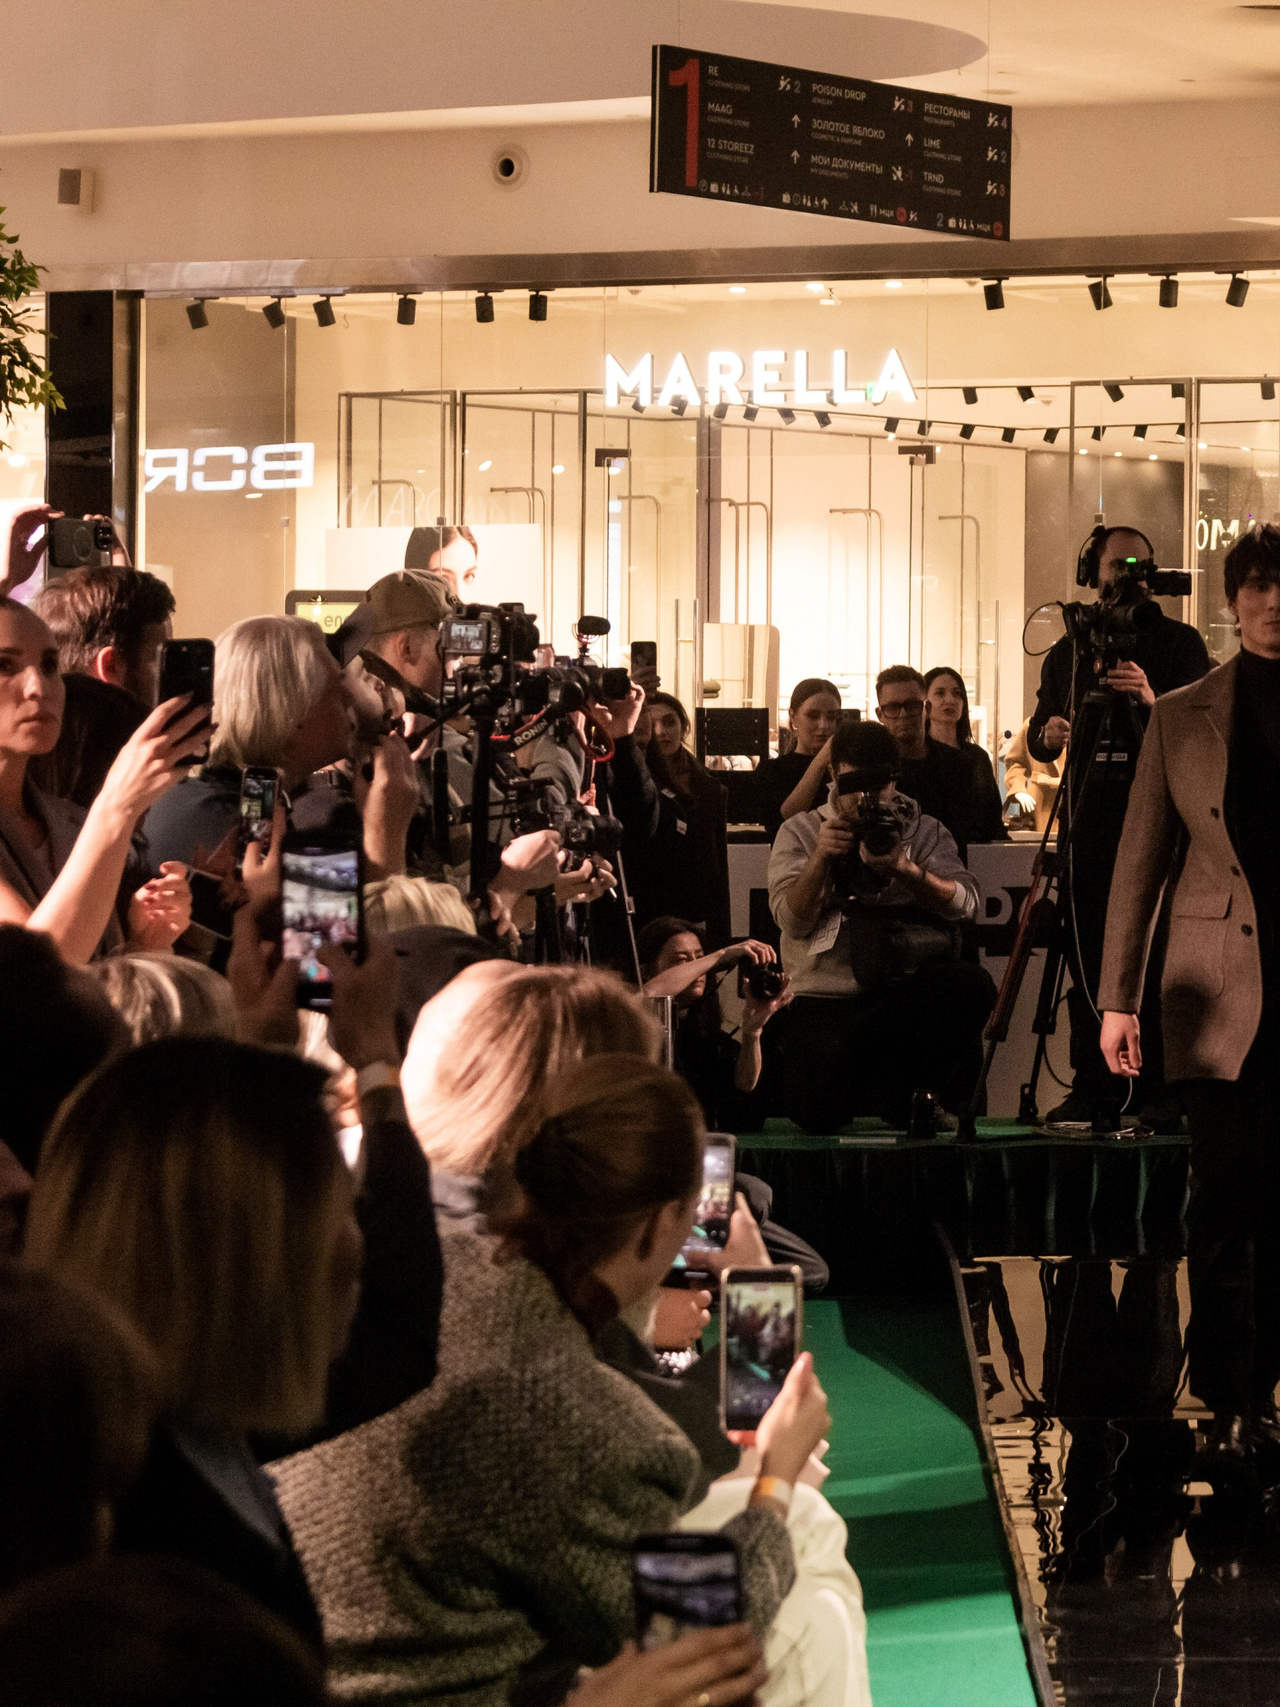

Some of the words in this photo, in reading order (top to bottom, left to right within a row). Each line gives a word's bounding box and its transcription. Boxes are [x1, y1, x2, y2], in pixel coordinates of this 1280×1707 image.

[708, 65, 719, 76] RE
[794, 80, 801, 93] 2
[812, 83, 843, 97] POISON
[844, 88, 867, 101] DROP
[707, 102, 733, 115] MAAG
[907, 100, 914, 113] 3
[924, 103, 970, 119] РЕСТОРАНЫ
[668, 58, 699, 188] 1
[811, 118, 850, 134] ЗОЛОТОЕ
[852, 125, 886, 139] ЯБЛОКО
[707, 138, 716, 148] 12
[718, 139, 755, 155] STOREEZ
[923, 137, 941, 149] LIME
[811, 154, 830, 165] МОИ
[831, 157, 883, 174] ДОКУМЕНТЫ
[1000, 151, 1007, 163] 2
[923, 171, 944, 184] TRND
[936, 212, 944, 227] 2
[605, 348, 917, 407] MARELLA
[513, 717, 548, 747] RONIN
